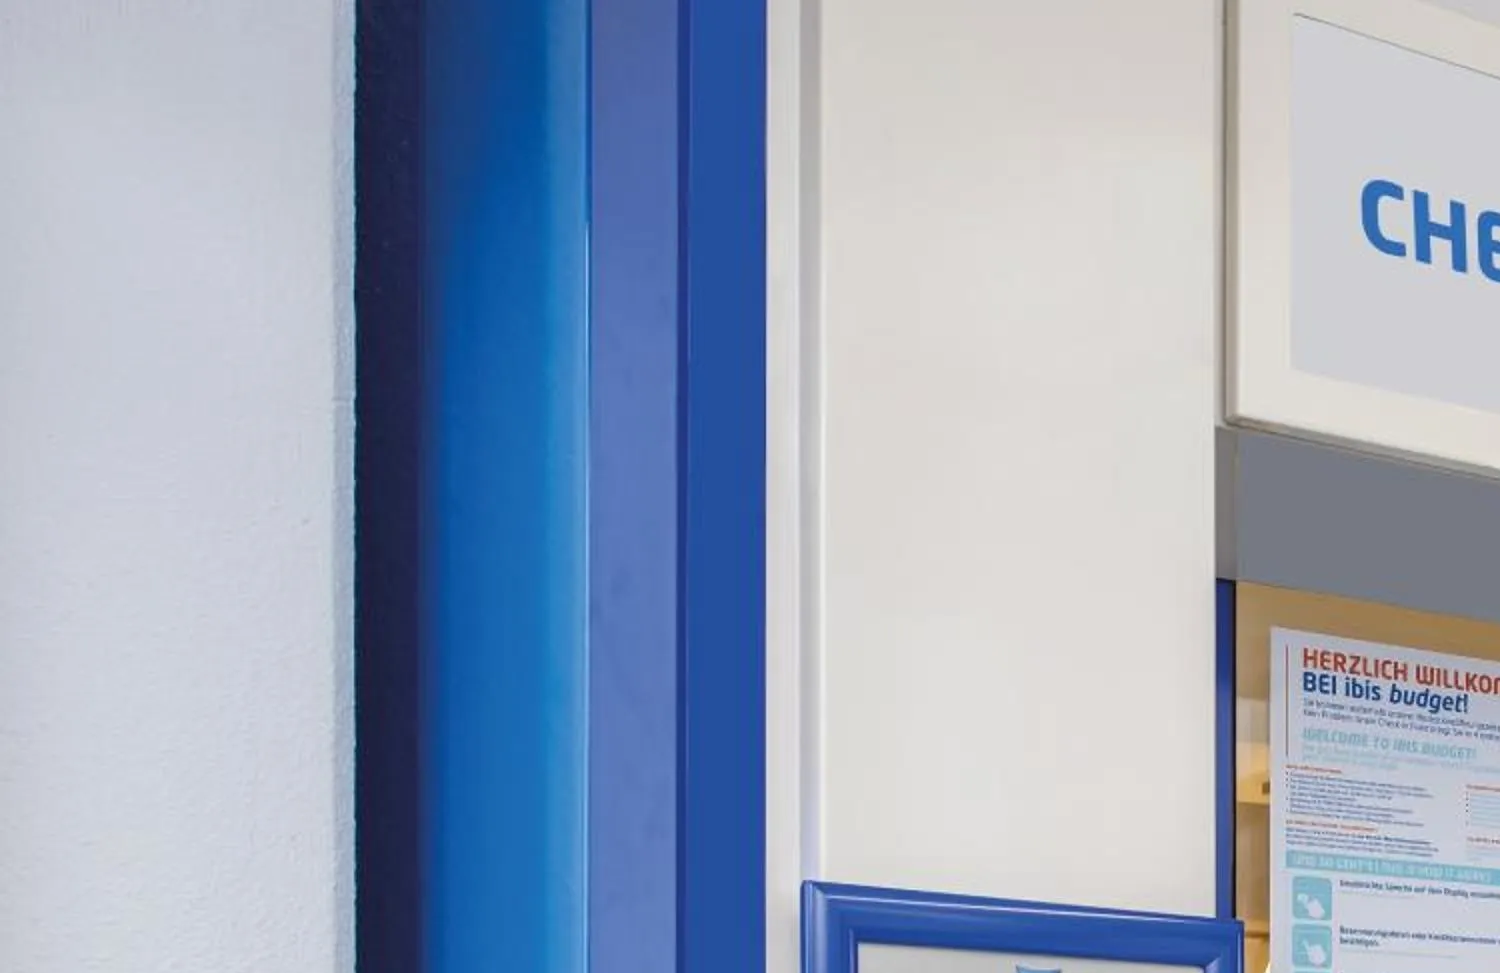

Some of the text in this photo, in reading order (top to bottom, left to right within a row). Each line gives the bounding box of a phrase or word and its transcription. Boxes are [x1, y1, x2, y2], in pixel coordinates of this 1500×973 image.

[1302, 647, 1409, 683] HERZLICH
[1302, 671, 1469, 714] BEI ibis budget!
